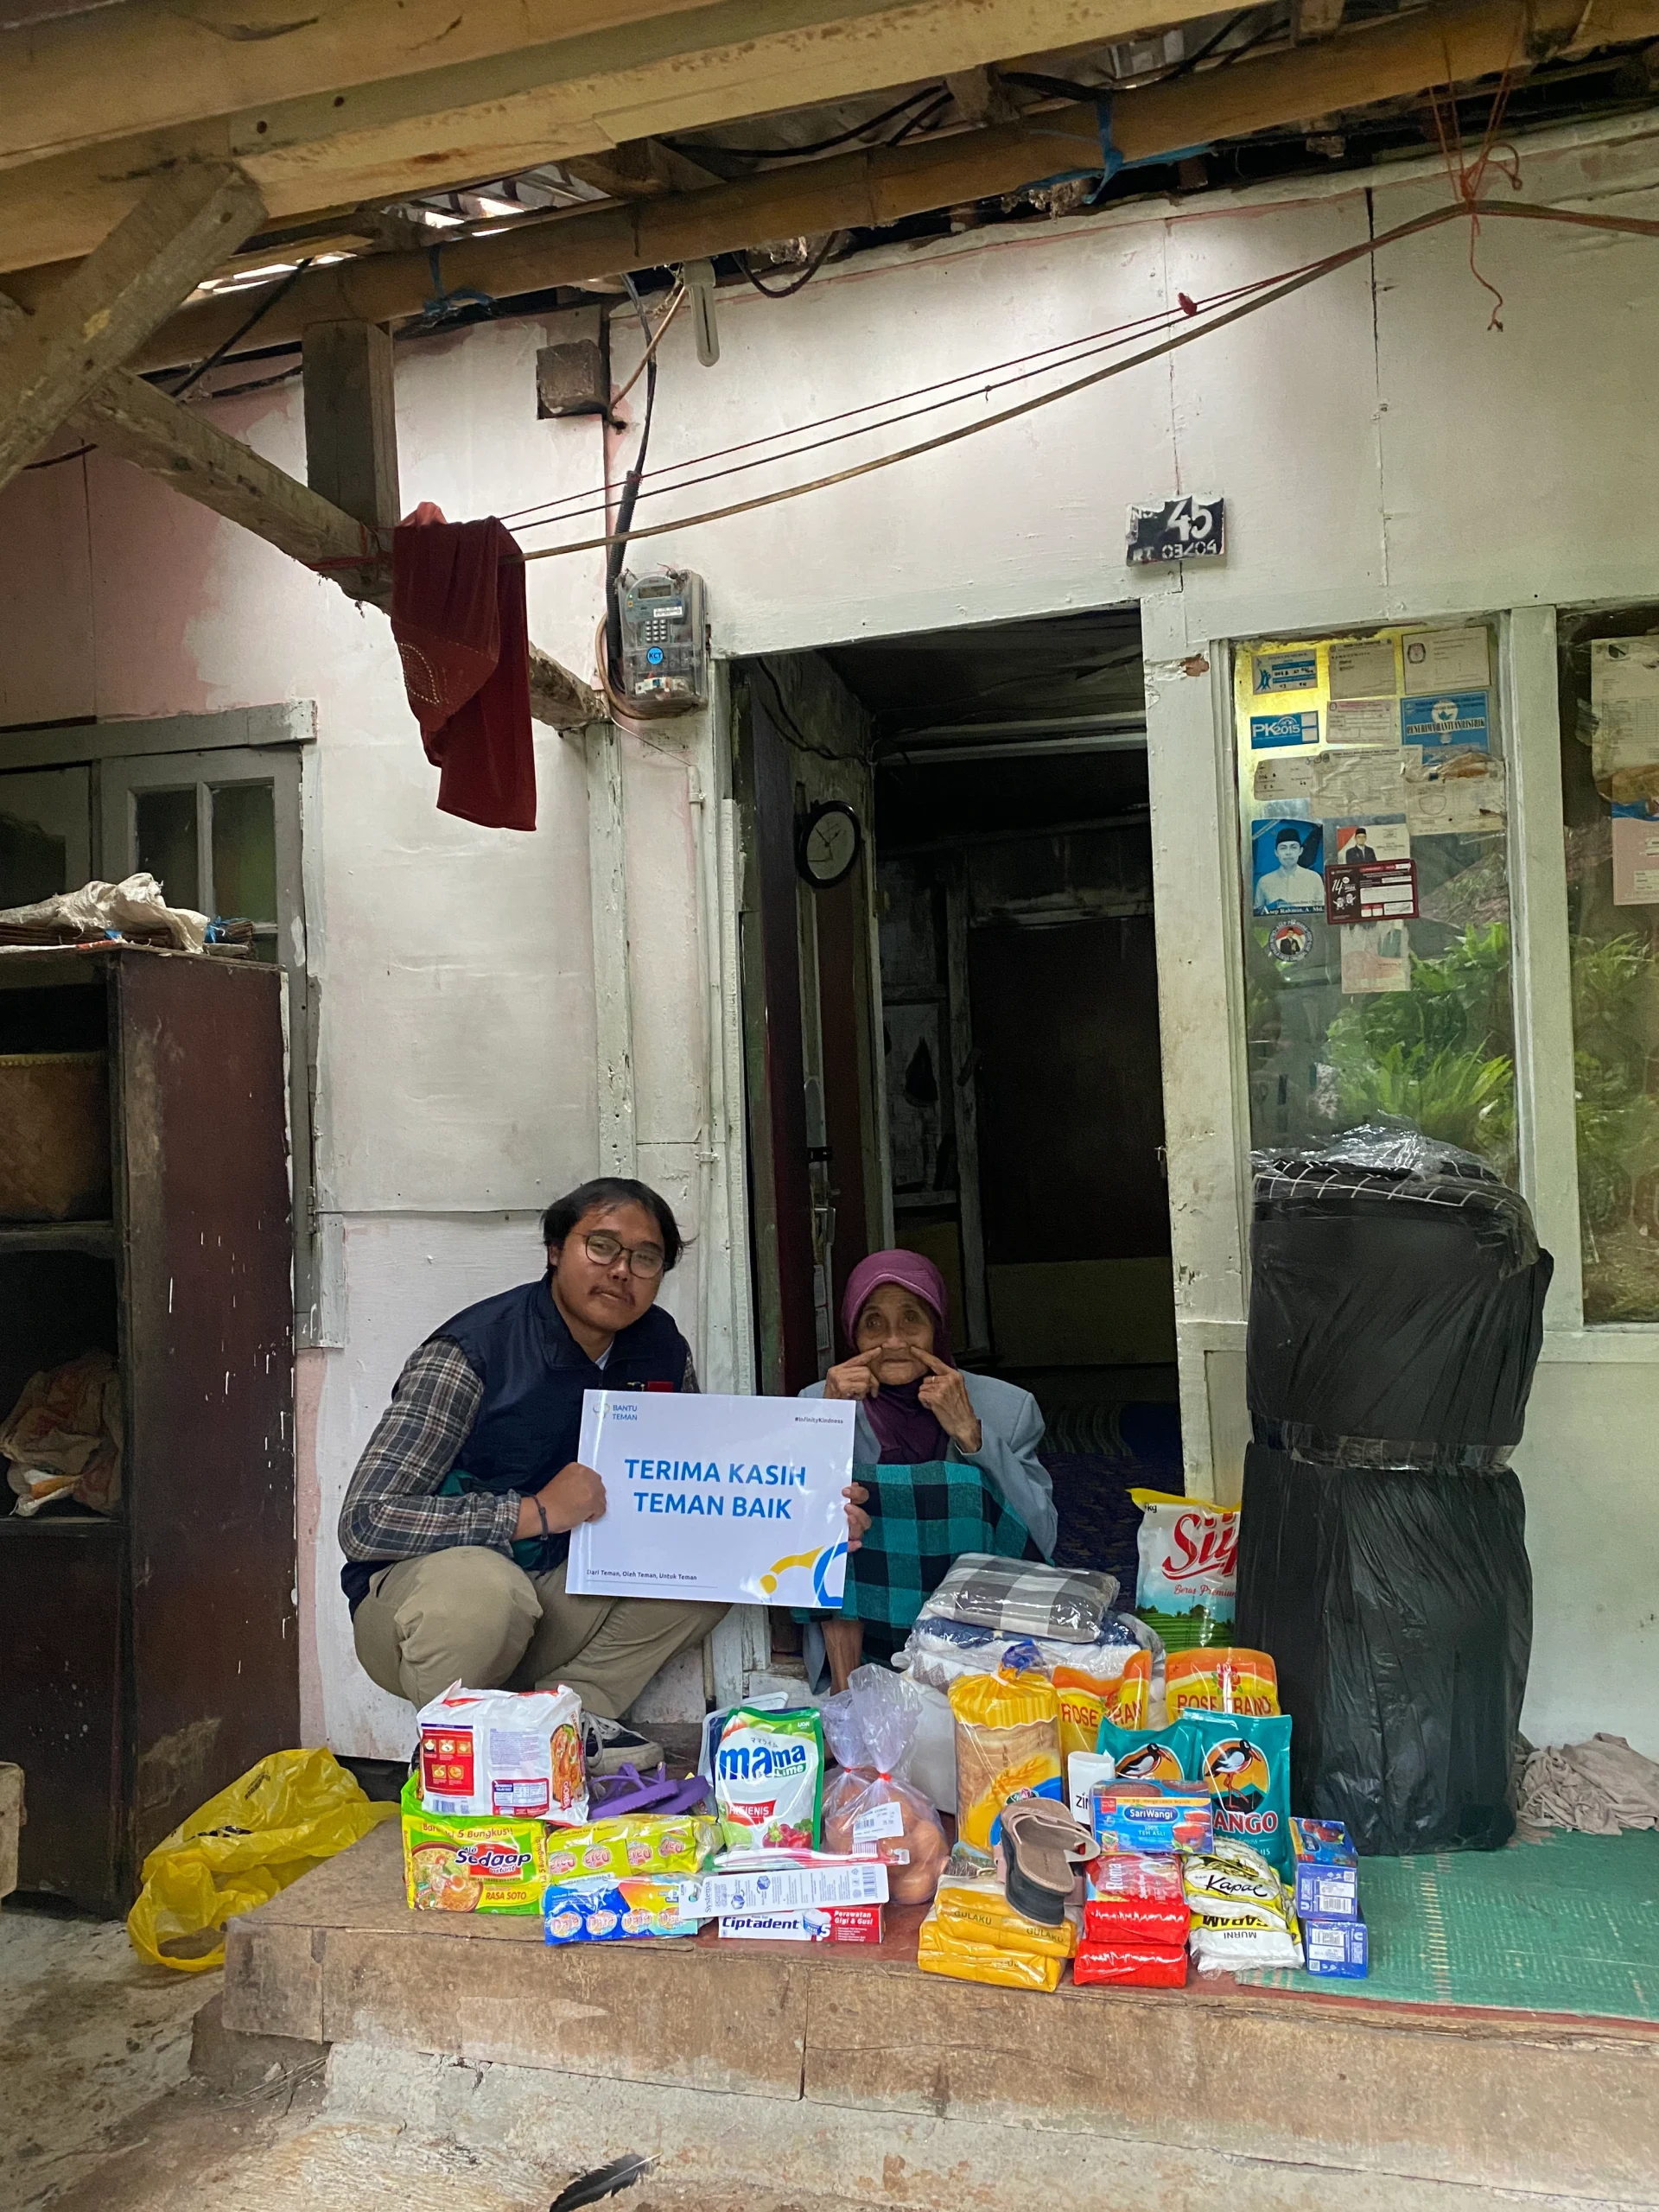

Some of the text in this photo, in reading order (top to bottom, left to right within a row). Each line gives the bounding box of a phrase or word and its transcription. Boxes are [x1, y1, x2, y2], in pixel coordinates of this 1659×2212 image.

[1168, 495, 1213, 542] 45
[624, 1459, 806, 1486] TERIMA KASIH
[633, 1492, 791, 1519] TEMAN BAIK
[1145, 1503, 1158, 1513] kg
[1174, 1585, 1197, 1595] Beras
[1178, 1694, 1271, 1715] ROSE BRAND
[1060, 1703, 1098, 1727] ROSE
[719, 1745, 806, 1781] mama
[774, 1764, 804, 1777] Lime
[1129, 1808, 1173, 1820] SariWangi
[1213, 1809, 1279, 1835] ANGO
[457, 1829, 464, 1838] 5
[454, 1850, 531, 1867] Sedaap
[1106, 1863, 1124, 1890] Roma
[486, 1891, 527, 1900] RASA SOTO
[722, 1916, 799, 1930] Ciptadent
[820, 1923, 831, 1937] 5
[954, 1910, 1064, 1943] GULAKU GULAKU
[1224, 1930, 1257, 1939] MURNI
